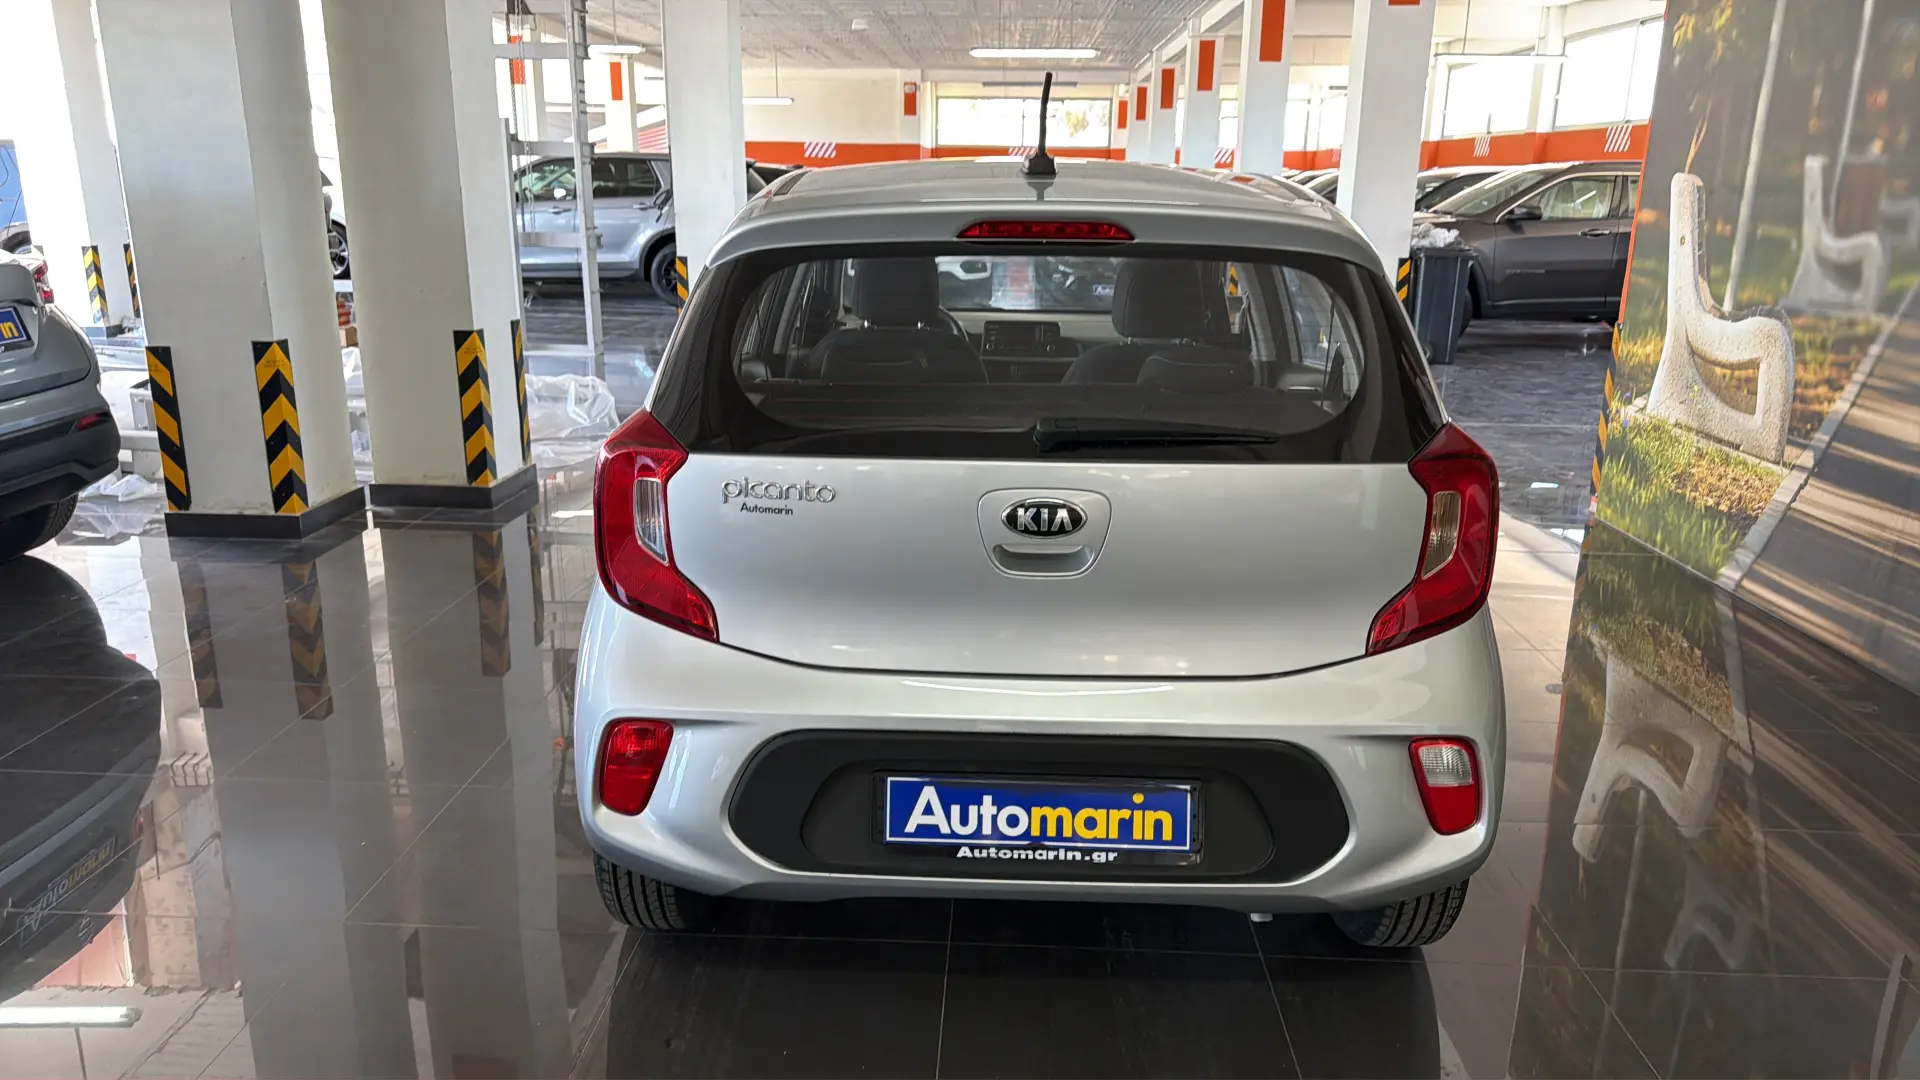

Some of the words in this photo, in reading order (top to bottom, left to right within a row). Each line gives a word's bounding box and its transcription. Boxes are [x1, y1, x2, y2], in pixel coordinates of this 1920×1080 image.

[0, 321, 19, 339] in
[721, 476, 836, 504] picanto
[740, 502, 793, 515] Automarin
[1017, 507, 1073, 531] KIA
[904, 785, 1172, 841] Automarin
[956, 845, 1118, 863] Automarin.gr
